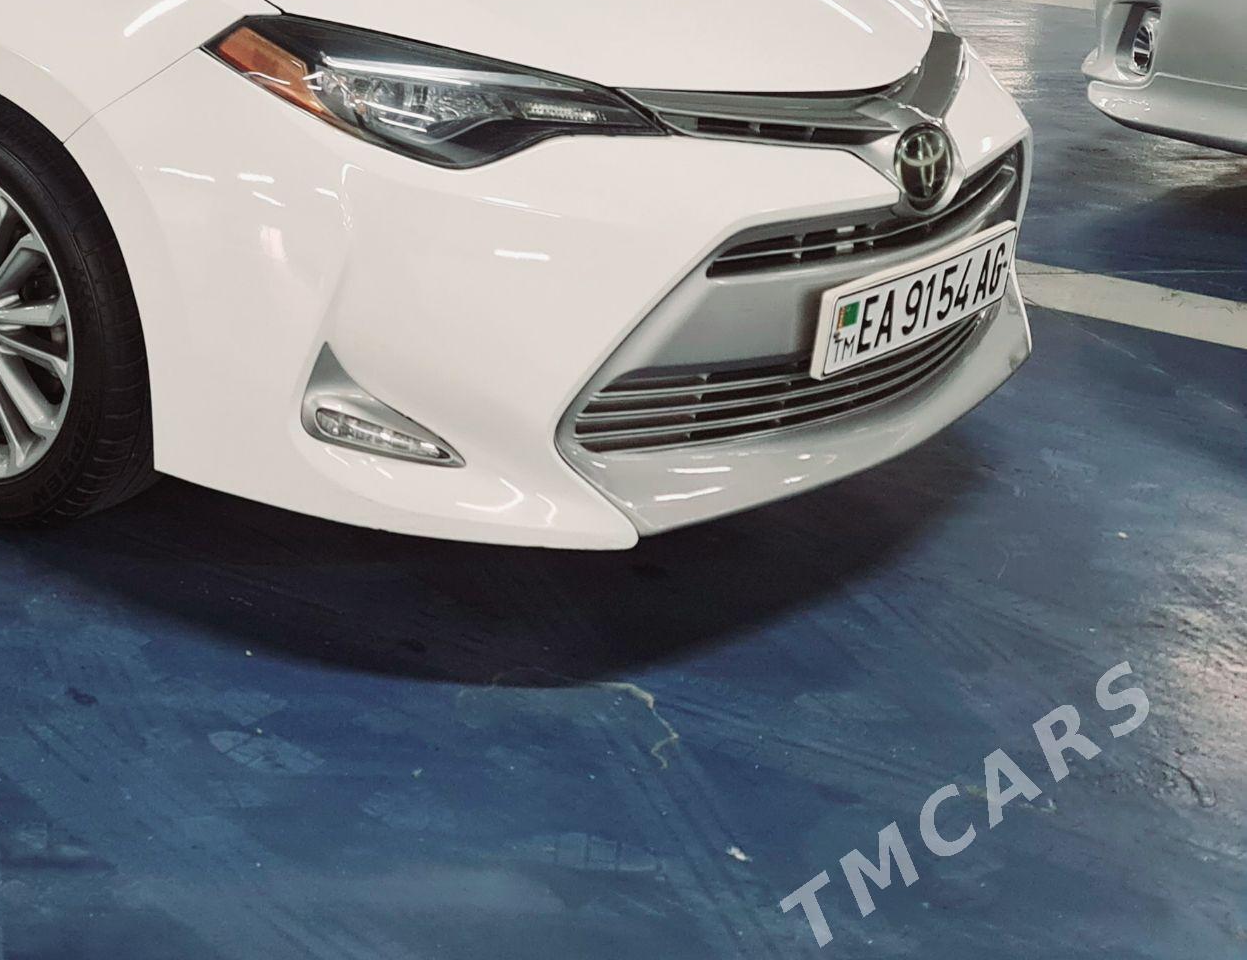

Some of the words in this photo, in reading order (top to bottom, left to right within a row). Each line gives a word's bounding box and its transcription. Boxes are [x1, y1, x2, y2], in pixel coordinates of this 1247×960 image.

[856, 289, 896, 354] EA
[901, 257, 973, 336] 9154
[972, 242, 1008, 306] AG
[834, 335, 855, 363] TM
